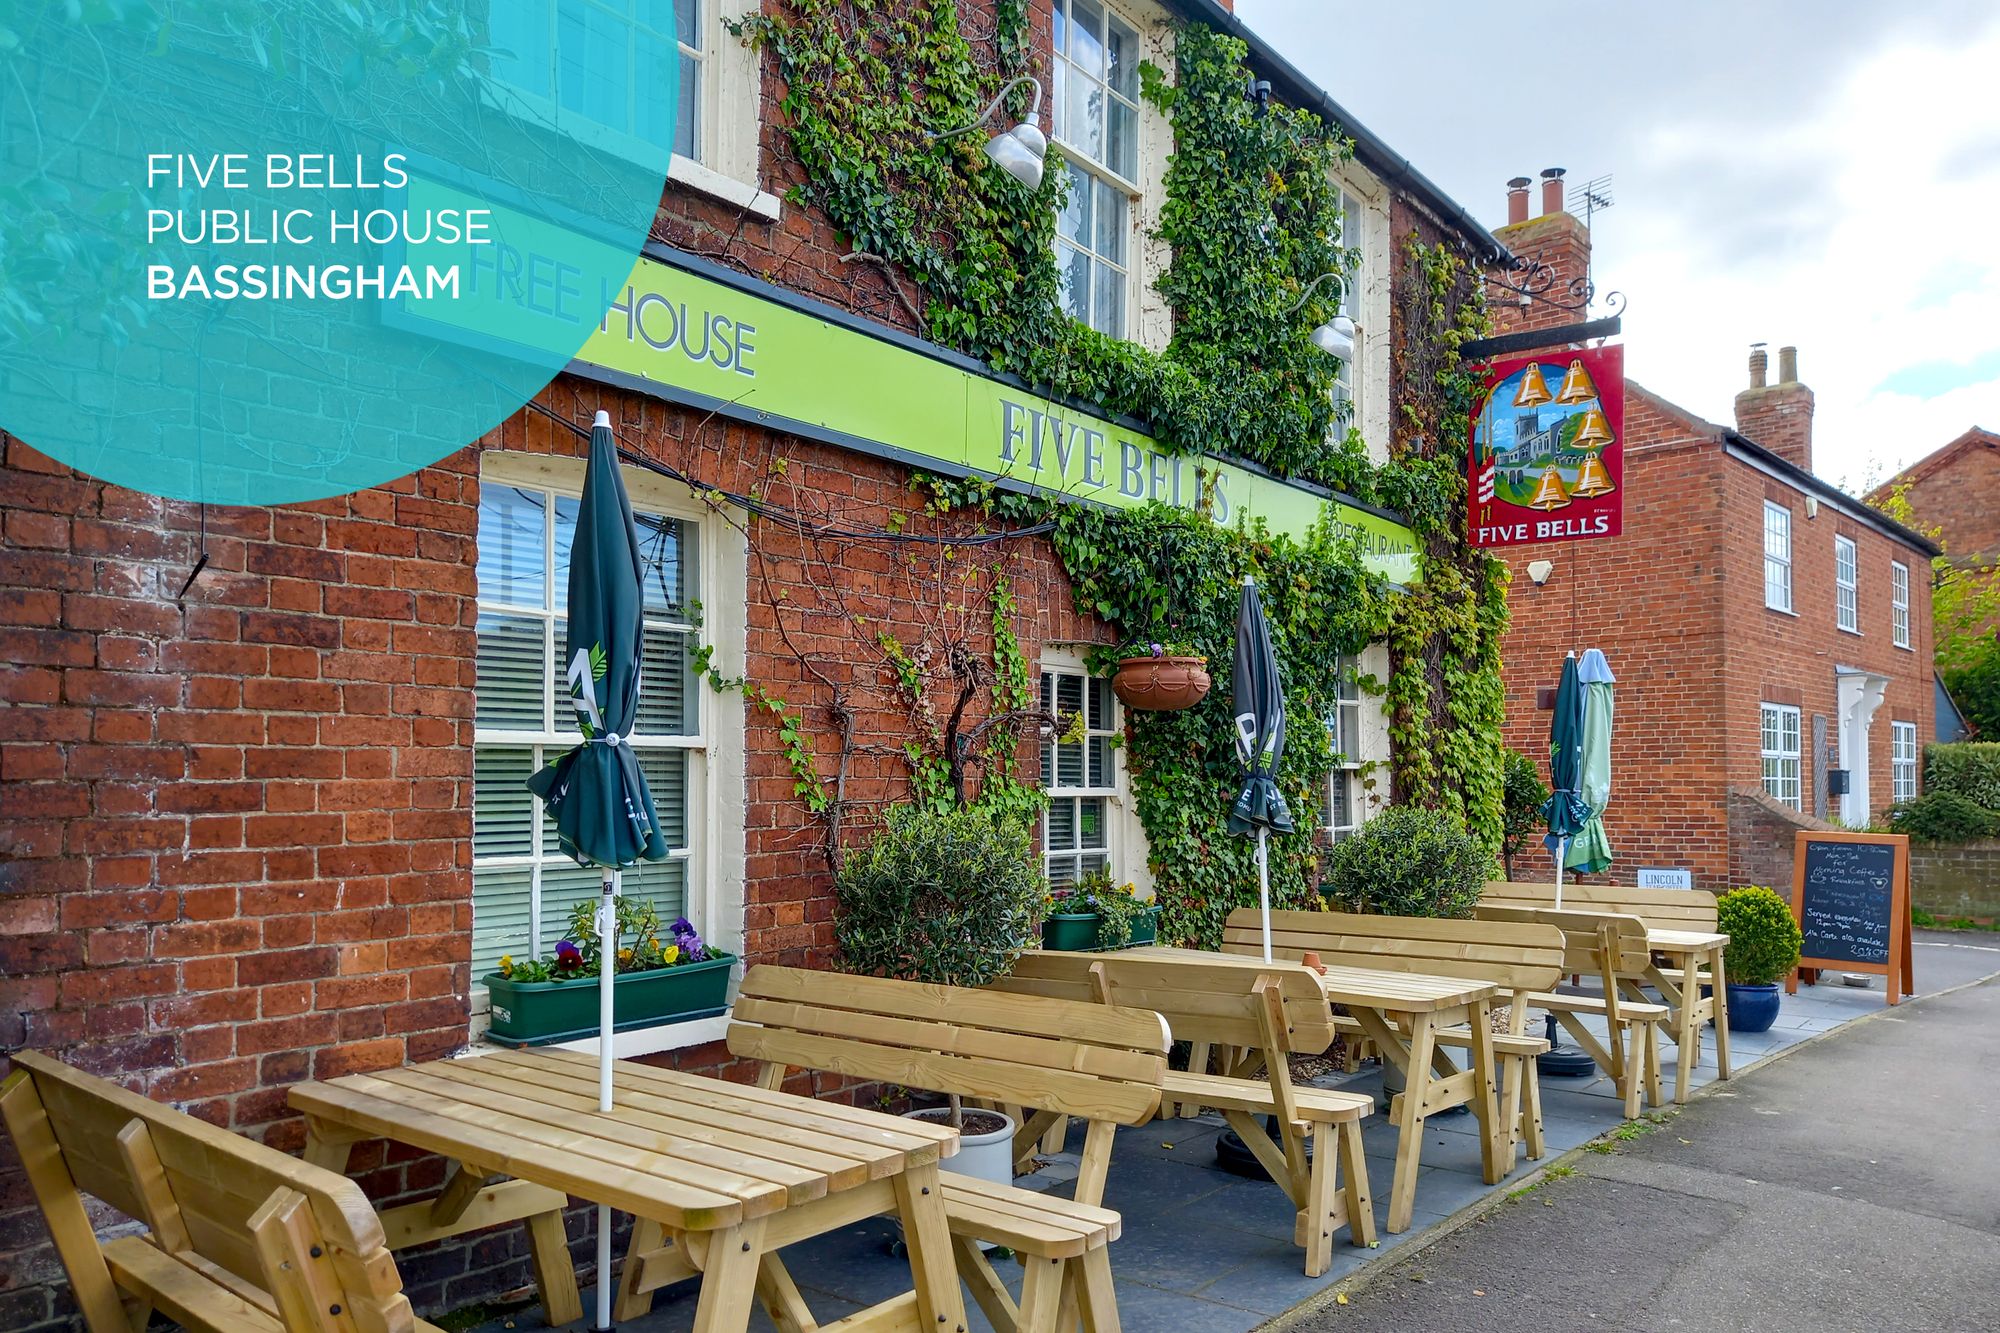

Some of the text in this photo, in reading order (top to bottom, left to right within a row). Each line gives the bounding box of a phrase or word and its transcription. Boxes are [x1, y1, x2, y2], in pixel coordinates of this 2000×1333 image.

[468, 236, 757, 379] FREE HOUSE
[998, 398, 1105, 489] FIVE
[1478, 515, 1610, 544] FIVE BELLS
[1645, 874, 1683, 885] LINCOLN
[1806, 907, 1831, 919] Served
